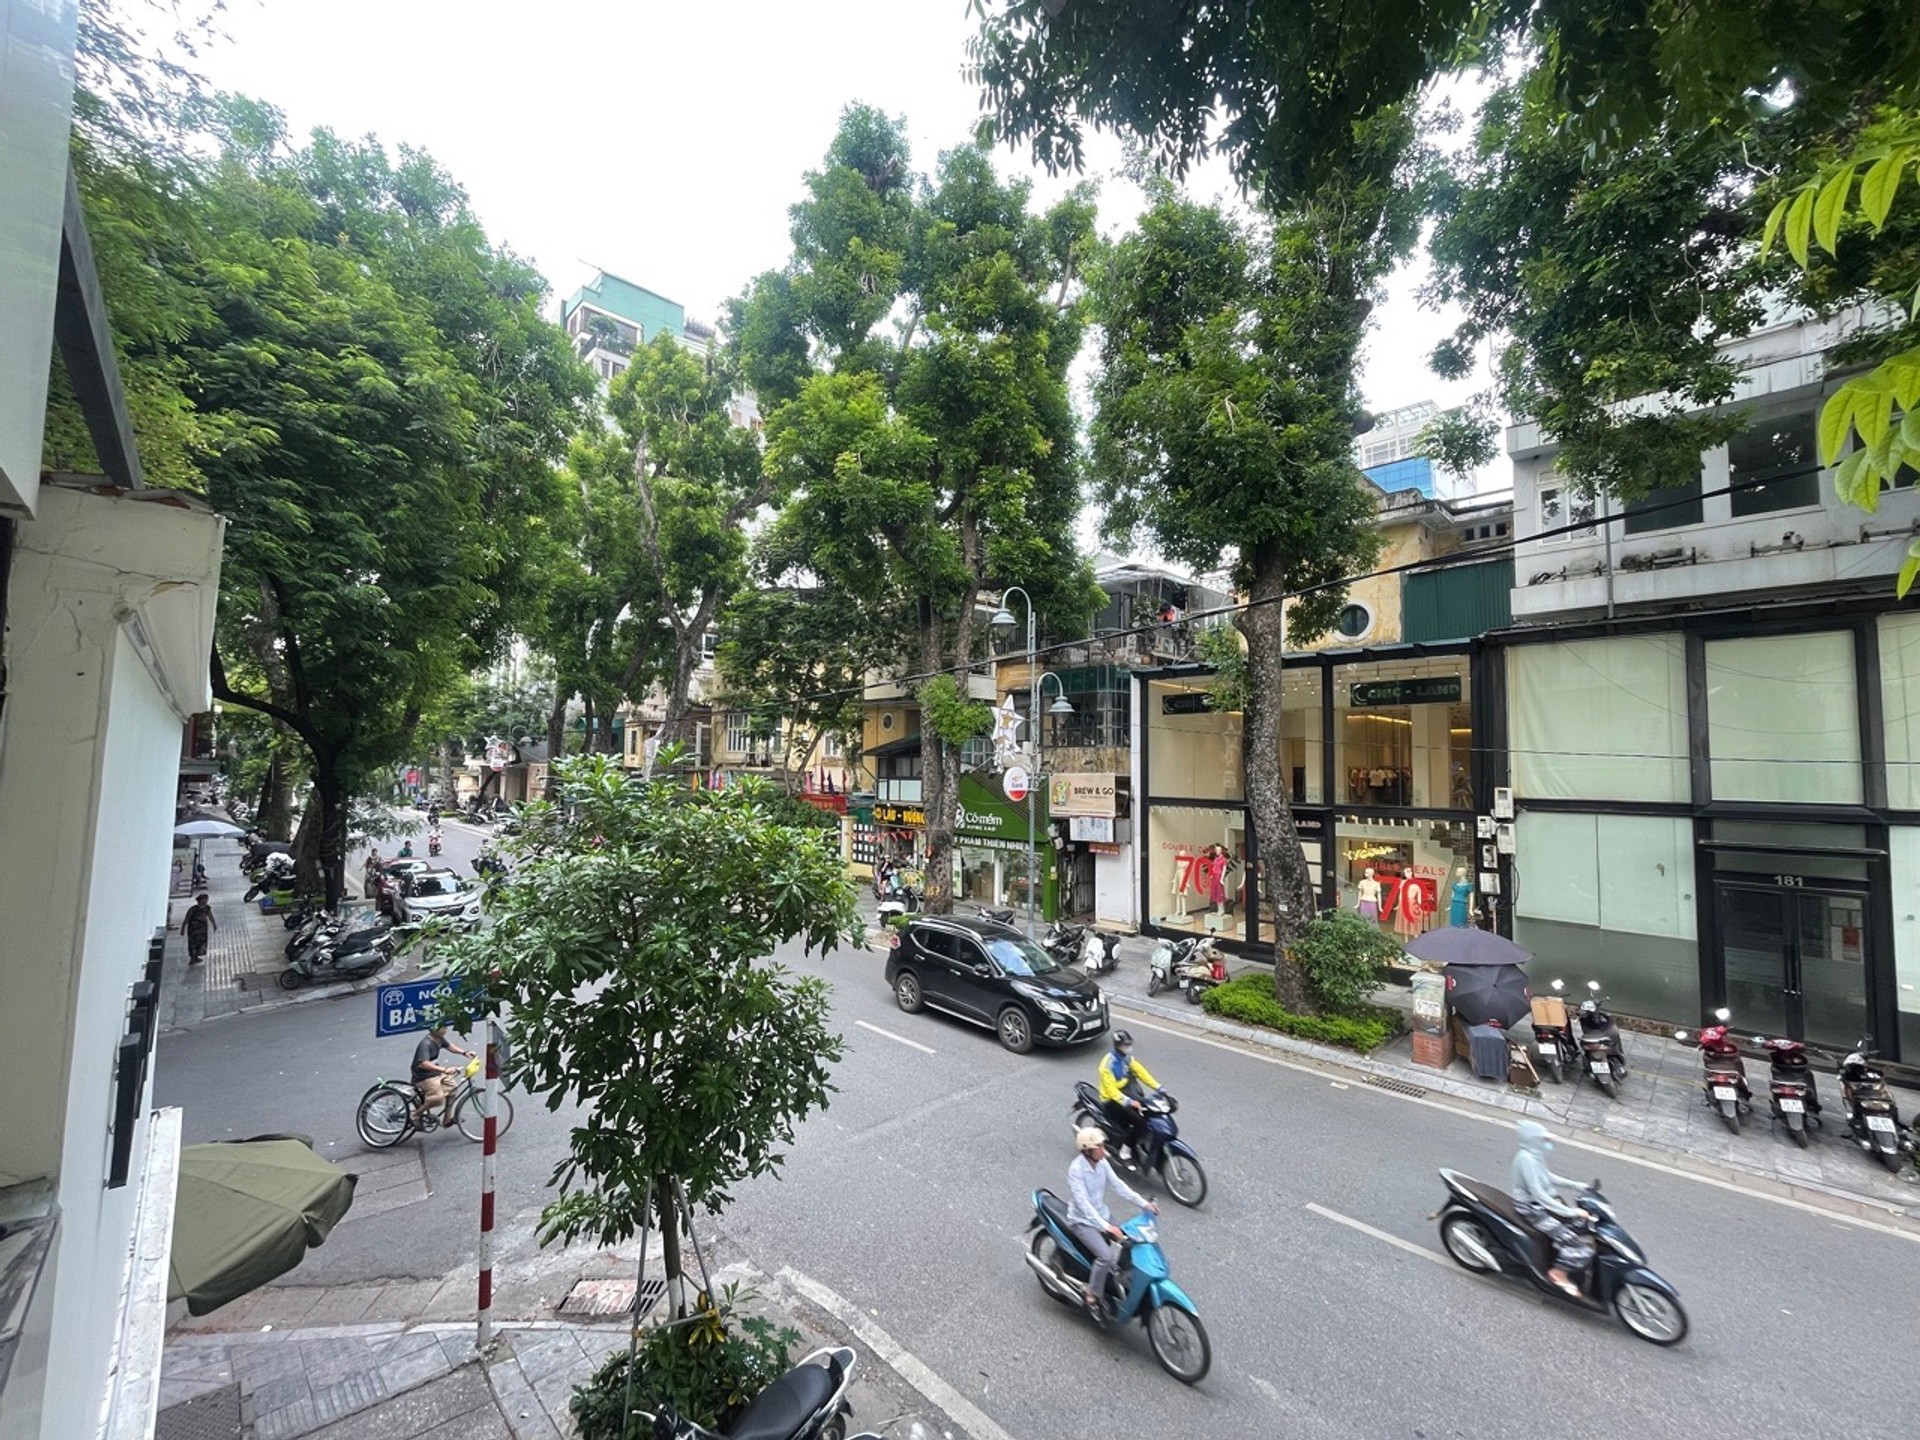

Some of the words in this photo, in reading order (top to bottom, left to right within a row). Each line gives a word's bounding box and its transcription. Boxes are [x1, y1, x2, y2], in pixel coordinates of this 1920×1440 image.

[1367, 686, 1402, 699] CHIC
[1415, 683, 1460, 696] LAND
[1073, 787, 1095, 795] BREW
[1095, 787, 1101, 795] &
[1102, 787, 1115, 796] GO
[1162, 842, 1194, 852] DOUBLE
[1774, 875, 1803, 888] 181
